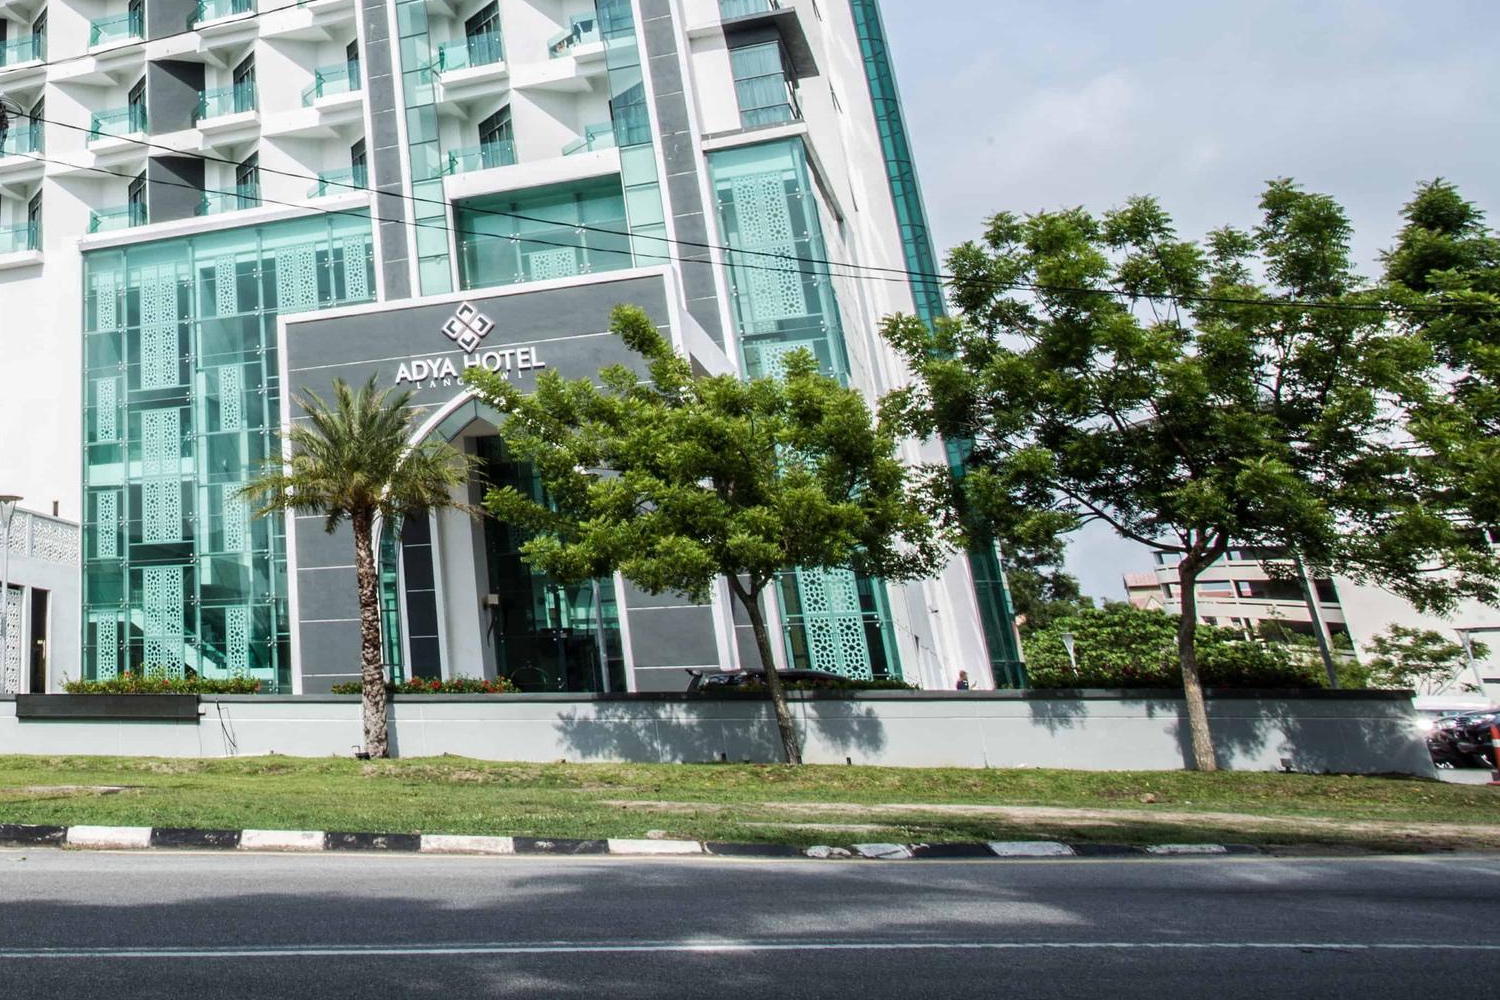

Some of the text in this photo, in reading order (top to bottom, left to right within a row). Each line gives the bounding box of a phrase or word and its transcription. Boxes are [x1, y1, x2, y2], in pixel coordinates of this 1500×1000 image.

[395, 346, 546, 384] ADYA HOTEL
[416, 370, 522, 390] LANGWI
